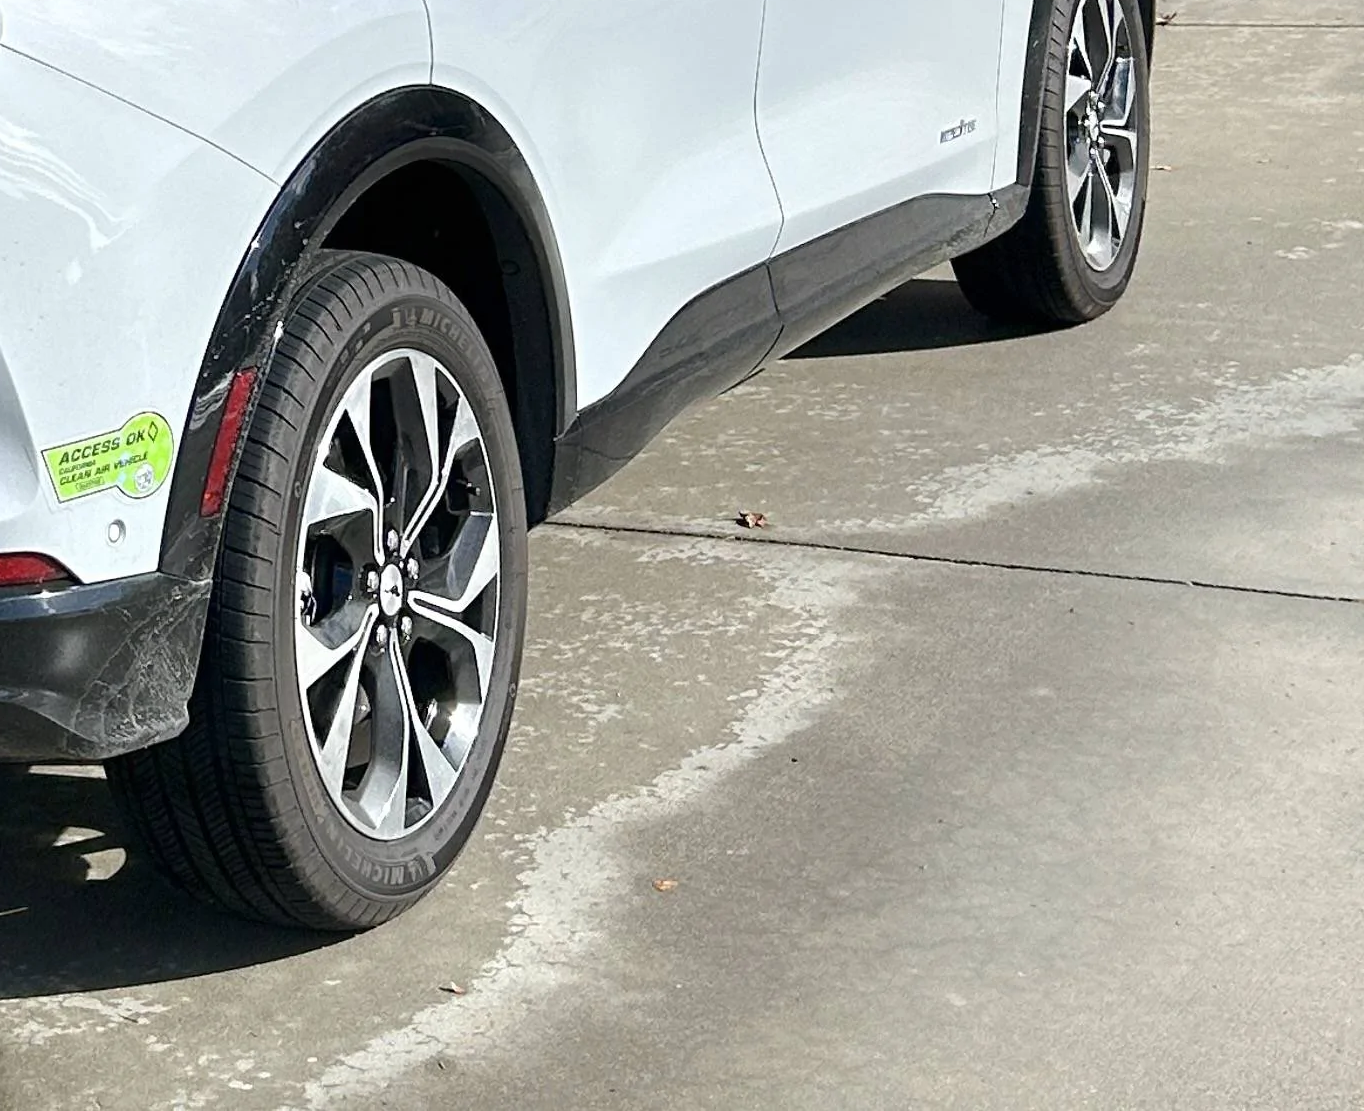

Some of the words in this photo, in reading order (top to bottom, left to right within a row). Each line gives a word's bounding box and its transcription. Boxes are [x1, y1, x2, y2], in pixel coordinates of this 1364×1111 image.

[59, 437, 120, 465] ACCESS
[126, 429, 146, 446] OK
[59, 469, 92, 486] CLEAN
[94, 463, 111, 476] AIR
